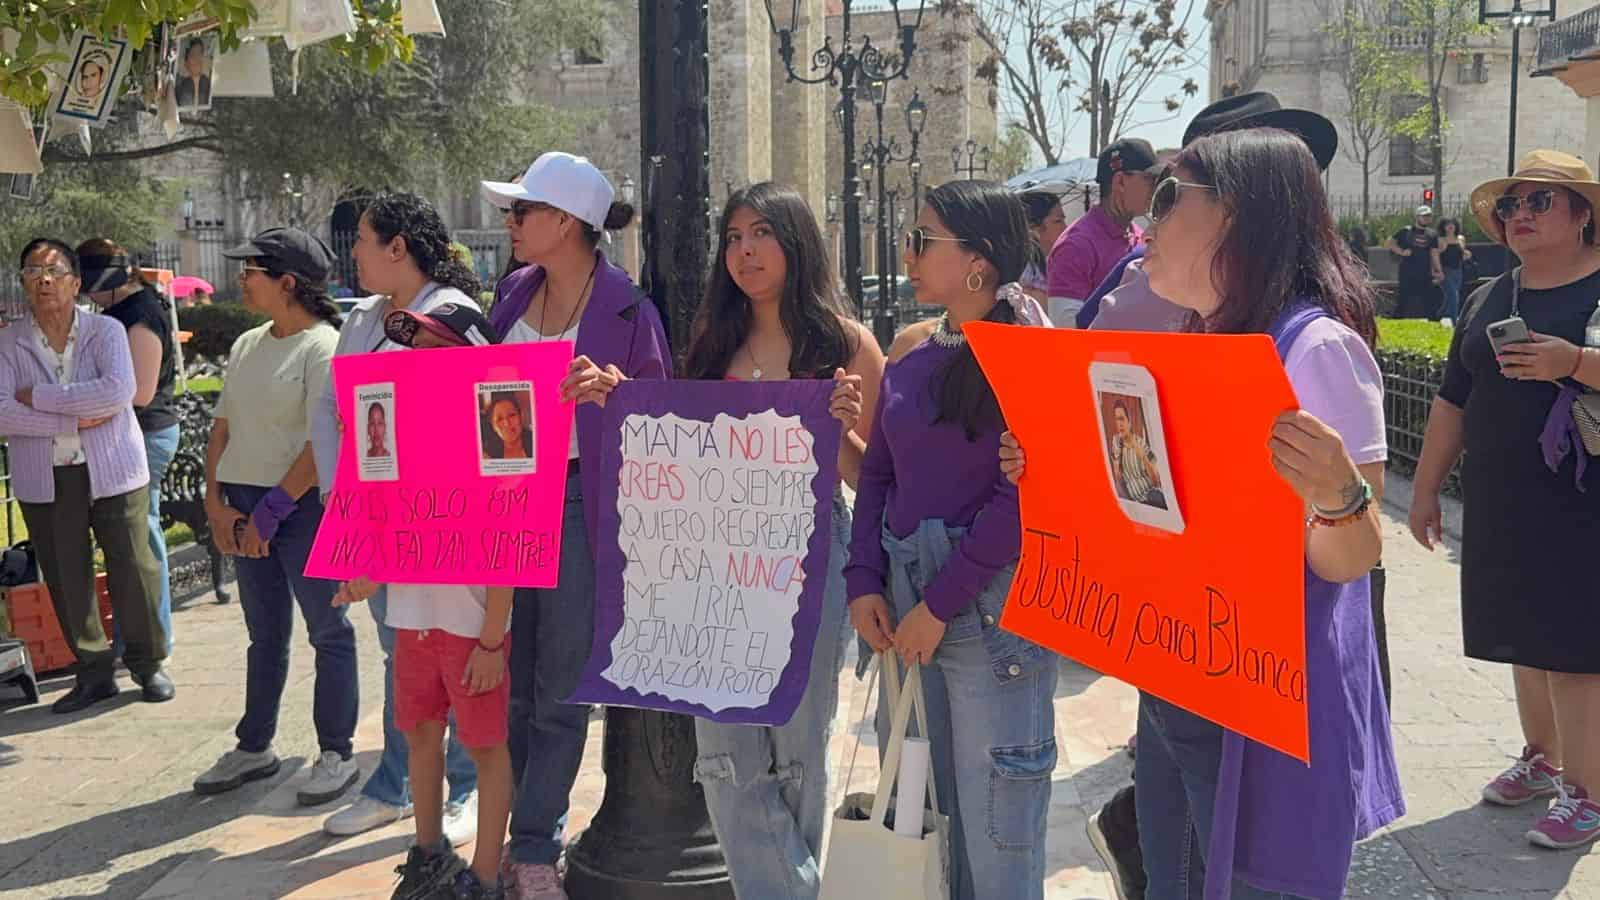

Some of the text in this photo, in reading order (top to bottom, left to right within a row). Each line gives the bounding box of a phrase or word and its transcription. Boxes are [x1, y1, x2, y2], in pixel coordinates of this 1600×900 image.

[623, 420, 810, 464] MAMÁ NO LES
[331, 490, 361, 520] NO
[400, 488, 466, 524] SOLO
[487, 487, 529, 519] 8M
[620, 459, 815, 508] CREAS YO SIEMPRE
[623, 504, 814, 550] QUIERO REGRESAR
[626, 542, 805, 594] A CASA NUNCA
[626, 582, 748, 628] ME IRÍA
[745, 631, 775, 671] EL
[1125, 602, 1197, 664] para
[1205, 585, 1305, 703] Blanca
[610, 653, 775, 694] CORAZÓN ROTO
